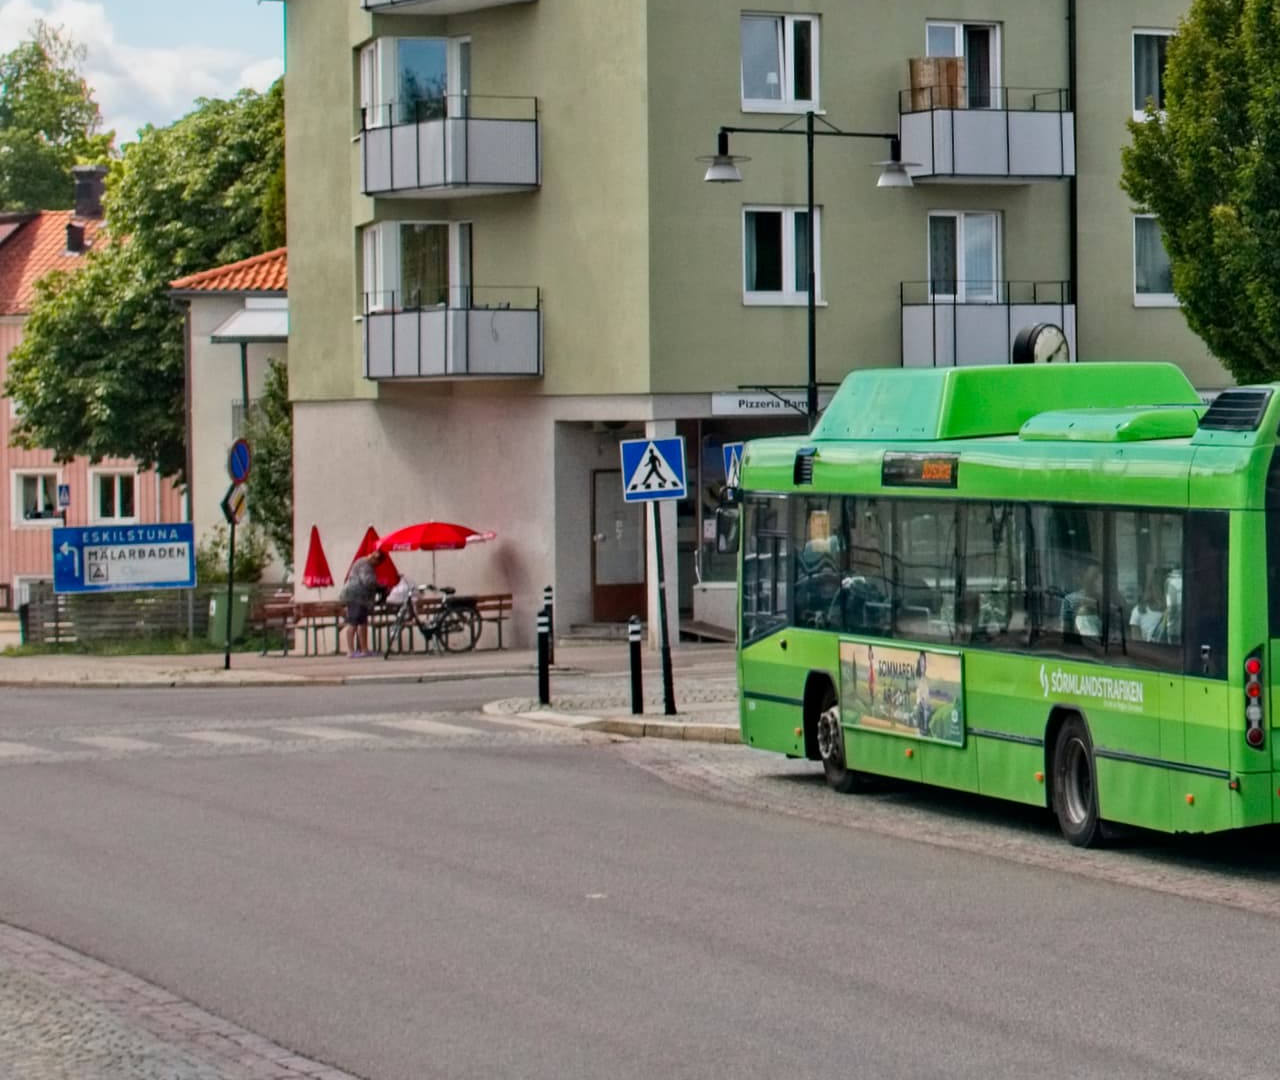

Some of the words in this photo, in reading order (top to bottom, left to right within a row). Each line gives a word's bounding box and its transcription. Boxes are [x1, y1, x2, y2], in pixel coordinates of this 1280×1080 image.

[738, 400, 780, 409] Pizzeria
[82, 528, 179, 543] ESKILSTUNA
[88, 546, 185, 561] MÄLARBADEN
[1051, 667, 1144, 703] SÖRMLANDSTRAFIKEN
